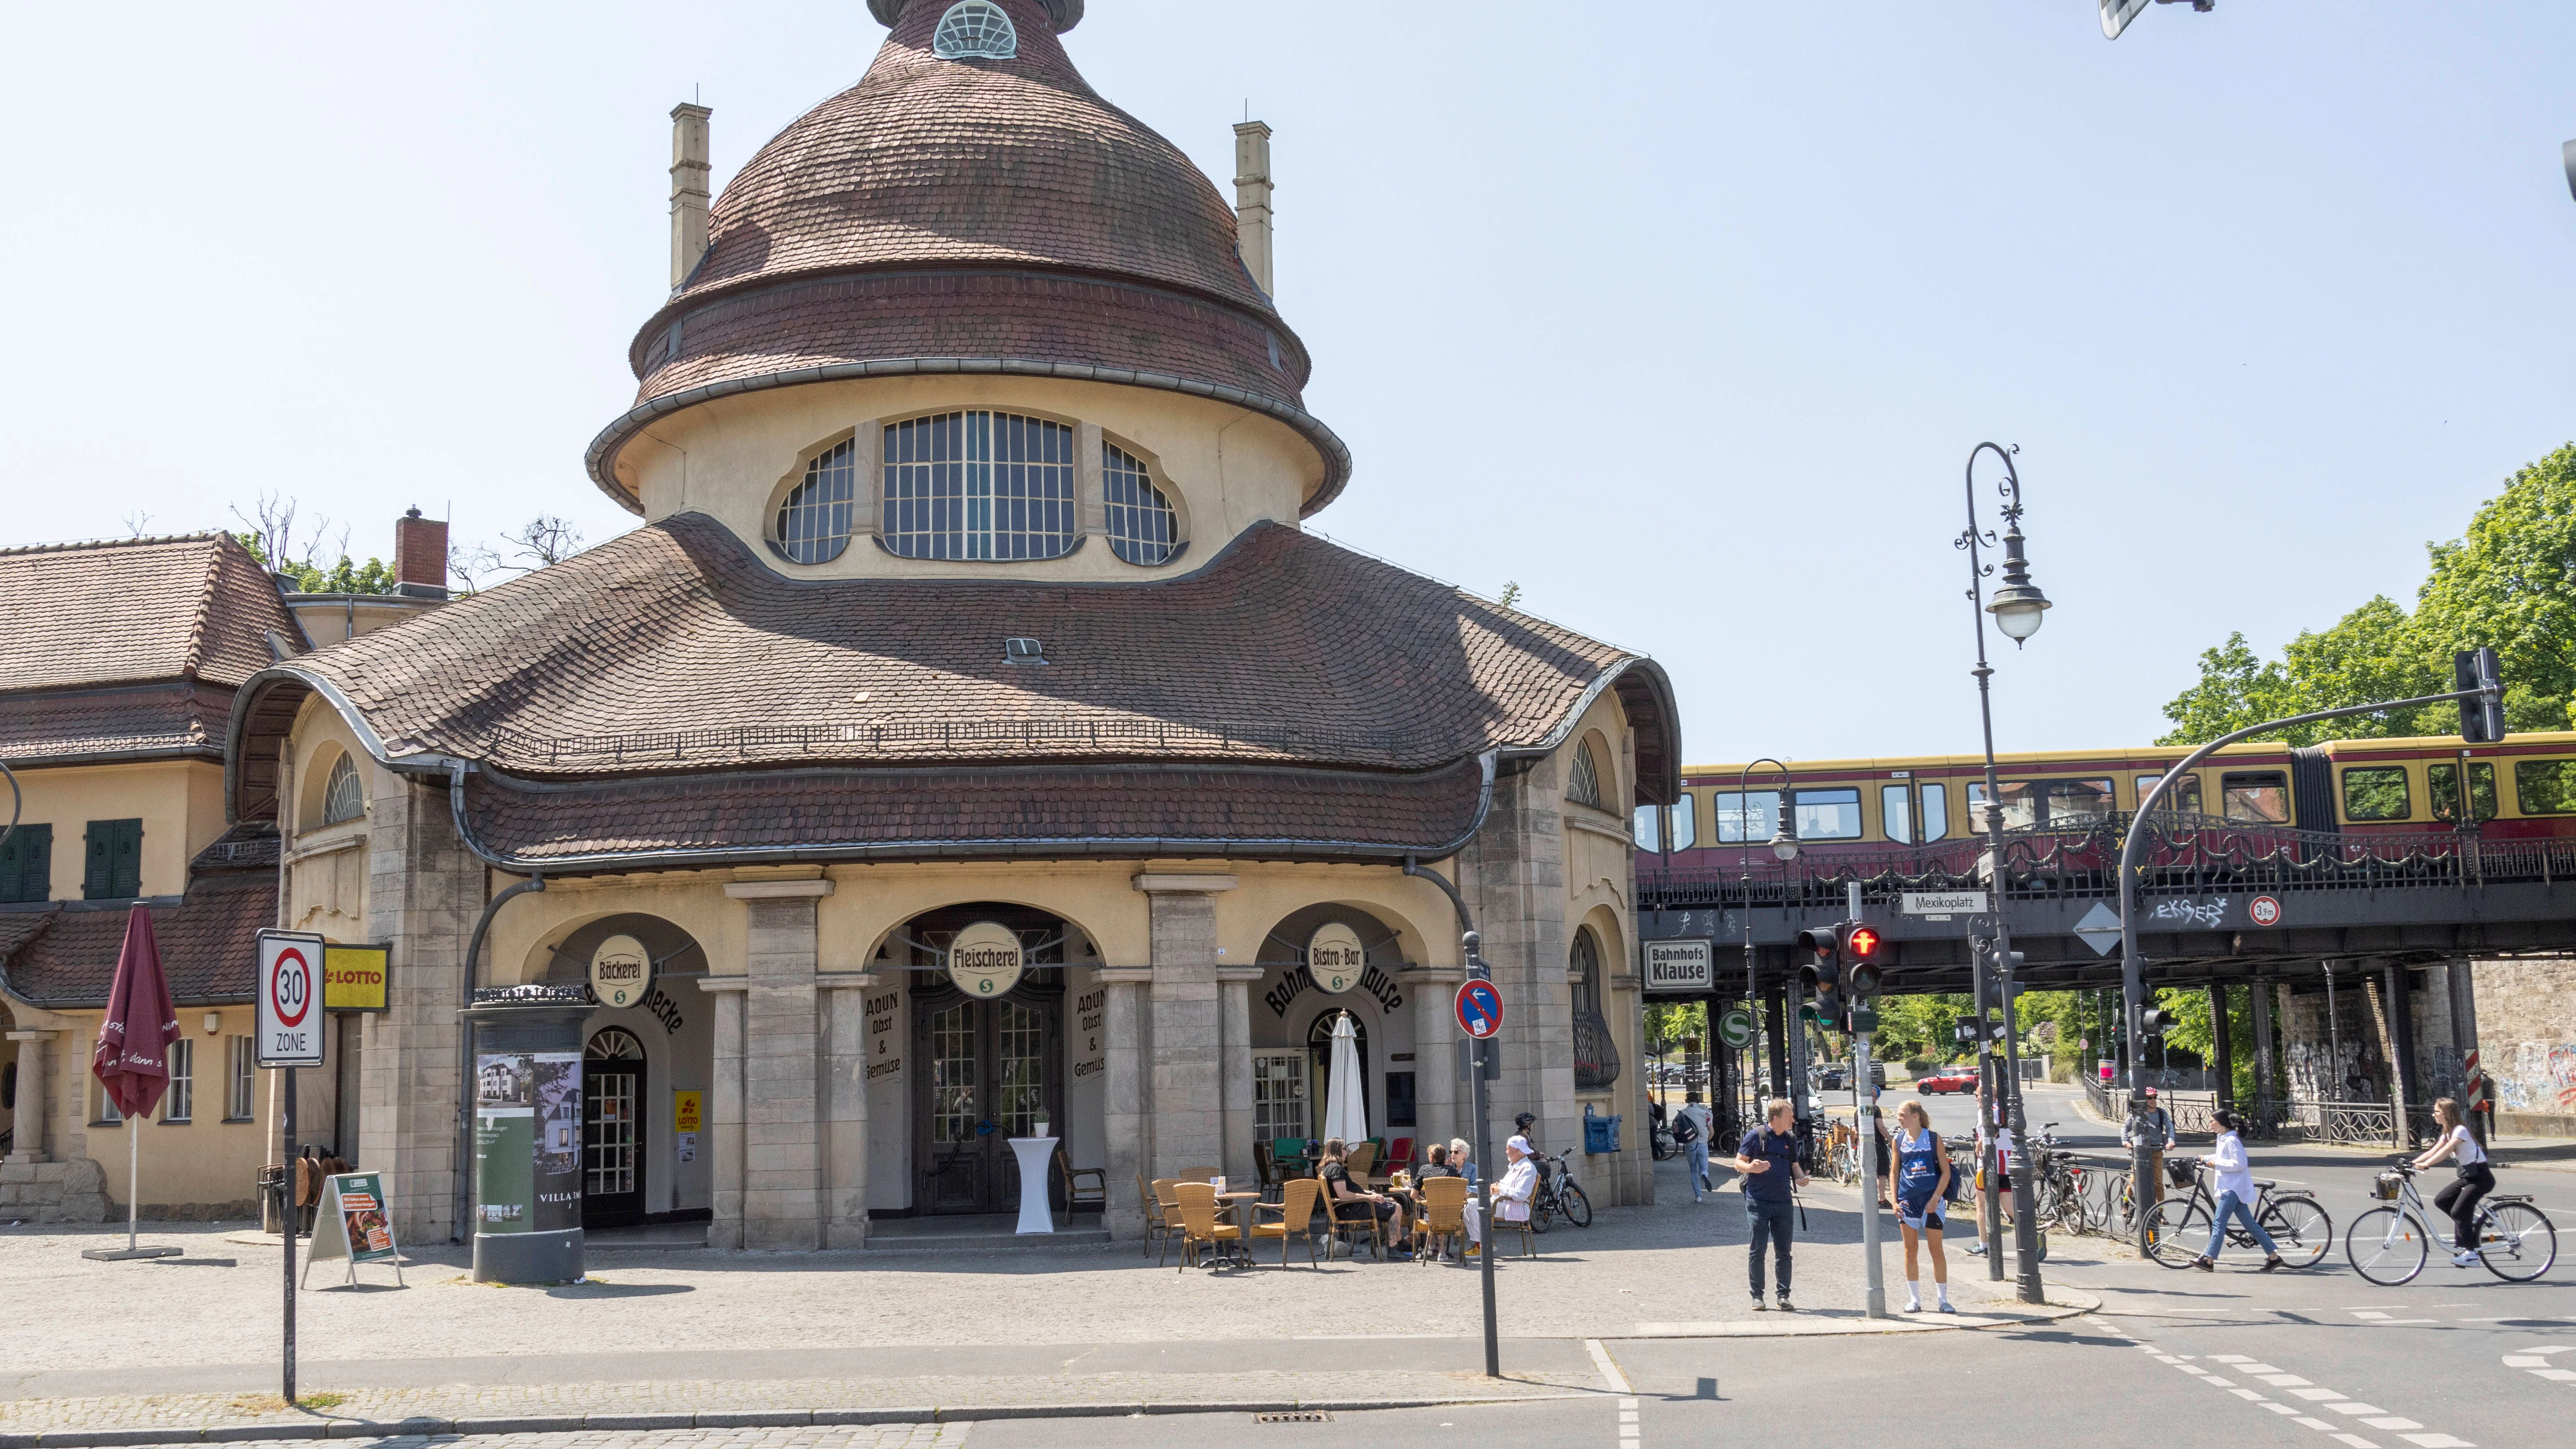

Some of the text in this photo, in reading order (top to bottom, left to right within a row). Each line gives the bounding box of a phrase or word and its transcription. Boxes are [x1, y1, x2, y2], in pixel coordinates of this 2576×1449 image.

[1916, 896, 1974, 910] Mexikoplatz
[954, 948, 1018, 968] Fleischerei
[1313, 948, 1339, 966] Bistro
[1344, 948, 1360, 965] Bar
[1652, 948, 1704, 960] Bahnhofs
[336, 970, 382, 985] LOTTO
[599, 961, 641, 980] Bäckerei
[1653, 962, 1704, 980] Klause
[280, 970, 302, 1005] 30
[1360, 965, 1403, 1015] ause
[873, 1017, 892, 1034] Obst
[1082, 1014, 1101, 1031] Obst
[1725, 1013, 1751, 1046] S
[276, 1033, 306, 1051] ZONE
[879, 1040, 886, 1054] &
[1089, 1037, 1096, 1051] &
[130, 1052, 153, 1065] dann
[539, 1192, 572, 1202] VILLA
